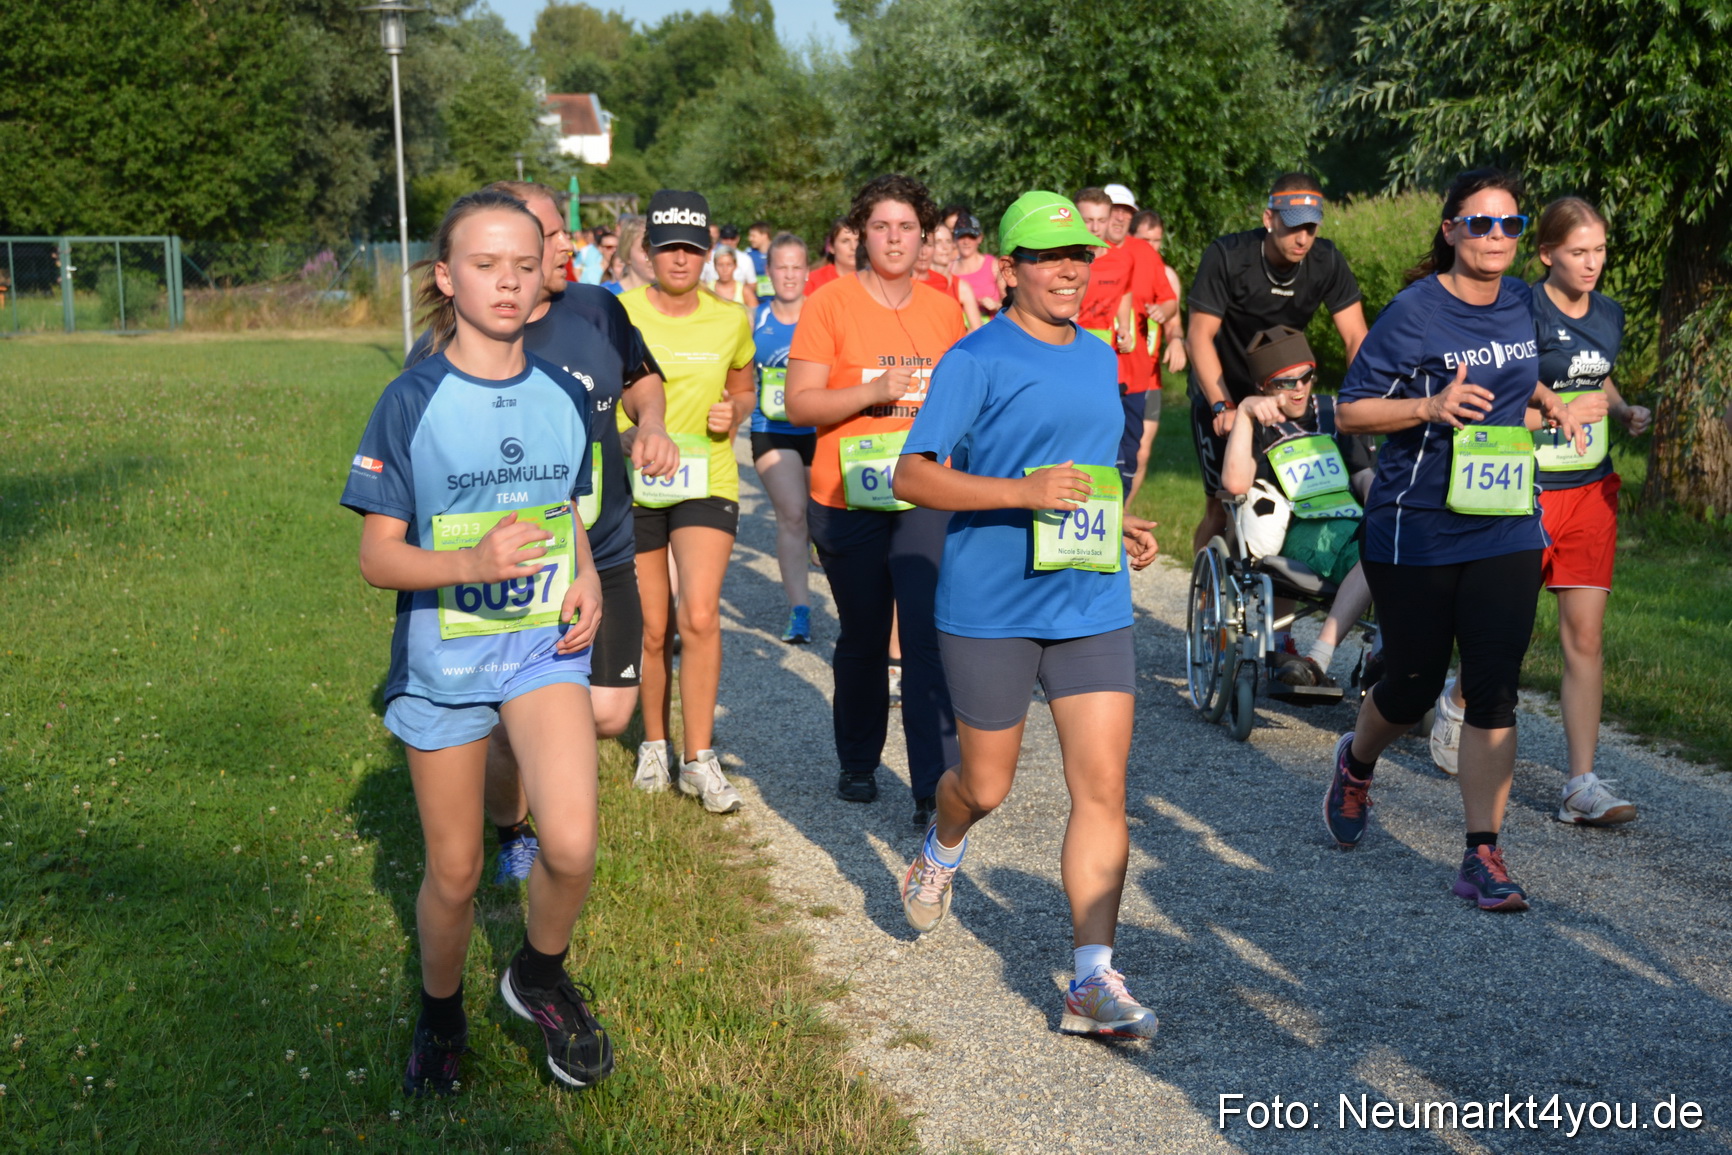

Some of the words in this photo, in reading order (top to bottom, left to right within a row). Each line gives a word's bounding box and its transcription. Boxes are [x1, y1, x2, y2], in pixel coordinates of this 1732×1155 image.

[652, 207, 707, 227] adidas
[878, 355, 896, 367] 30
[900, 355, 932, 367] Jahre
[1444, 347, 1492, 370] EURO
[1286, 457, 1340, 484] 1215
[1461, 462, 1523, 490] 1541
[496, 491, 529, 504] TEAM
[441, 522, 480, 537] 2013
[1054, 507, 1106, 542] 794
[1058, 547, 1076, 555] Nicole
[1076, 548, 1091, 556] Silvia
[455, 563, 558, 613] 6097
